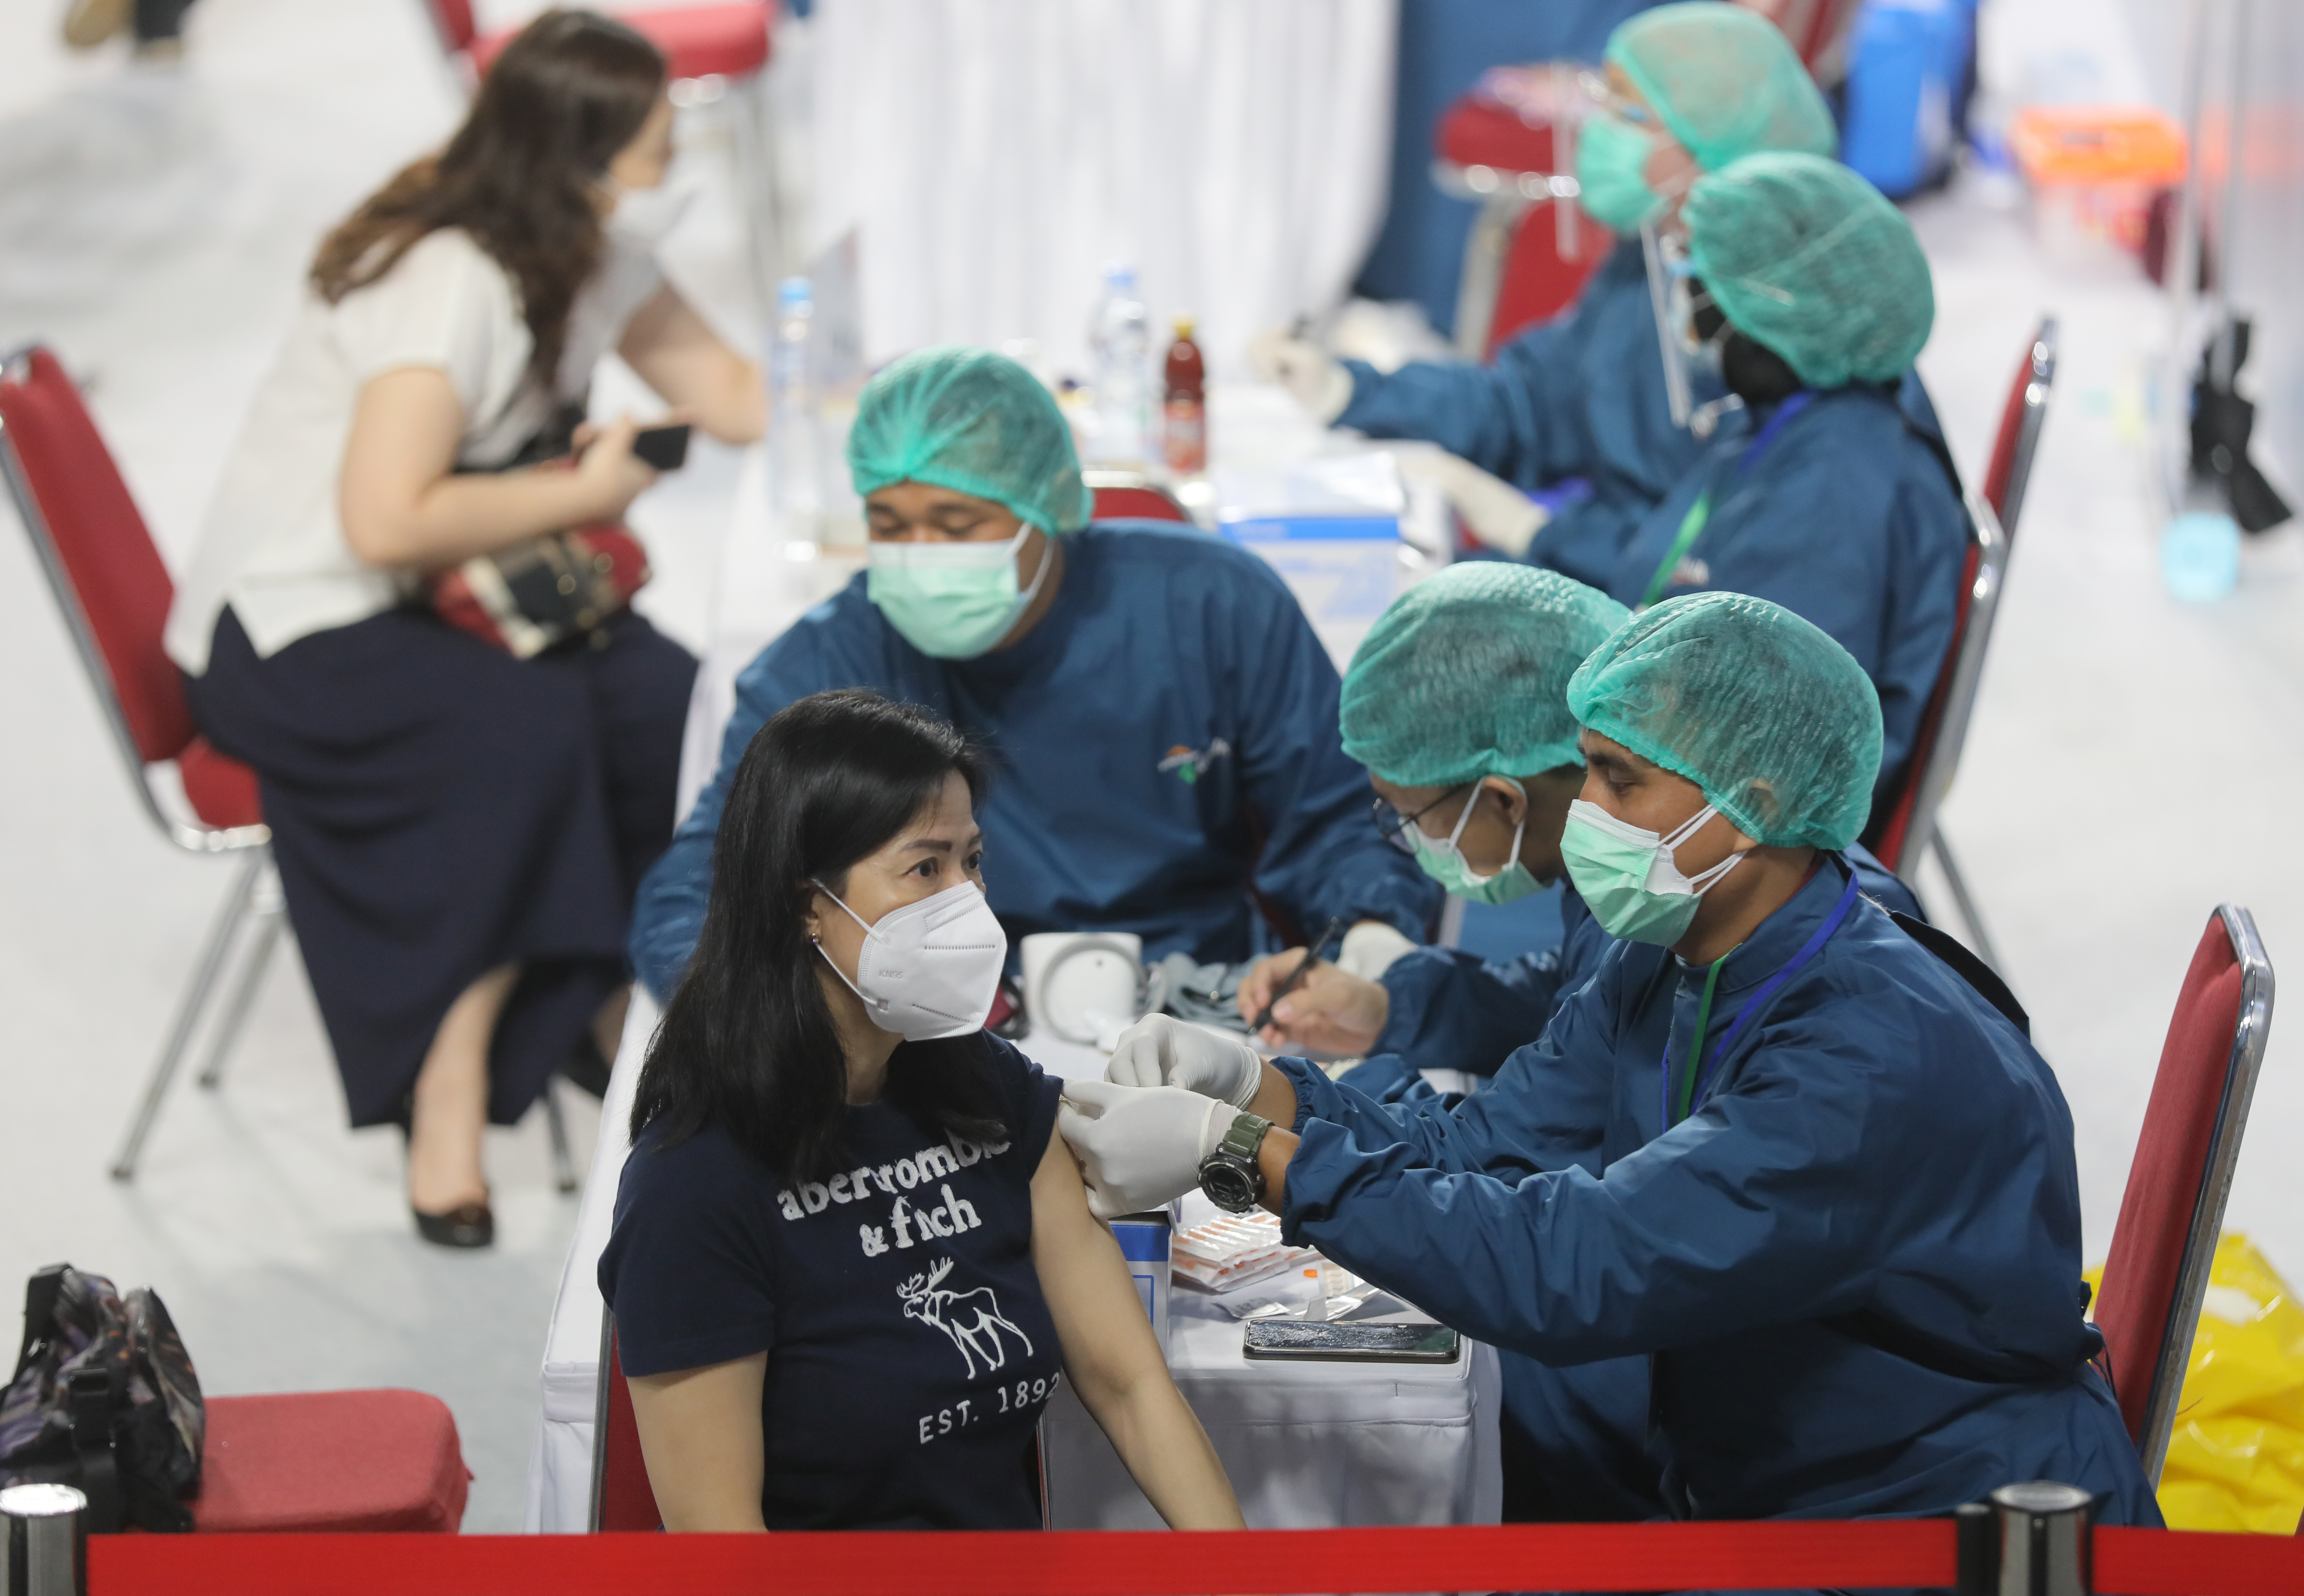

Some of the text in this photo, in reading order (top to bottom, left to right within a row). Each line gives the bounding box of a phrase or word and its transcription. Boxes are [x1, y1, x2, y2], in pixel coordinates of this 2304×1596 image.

[879, 970, 903, 979] KN95
[859, 1224, 889, 1257] &
[919, 1372, 1060, 1444] EST. 1892
